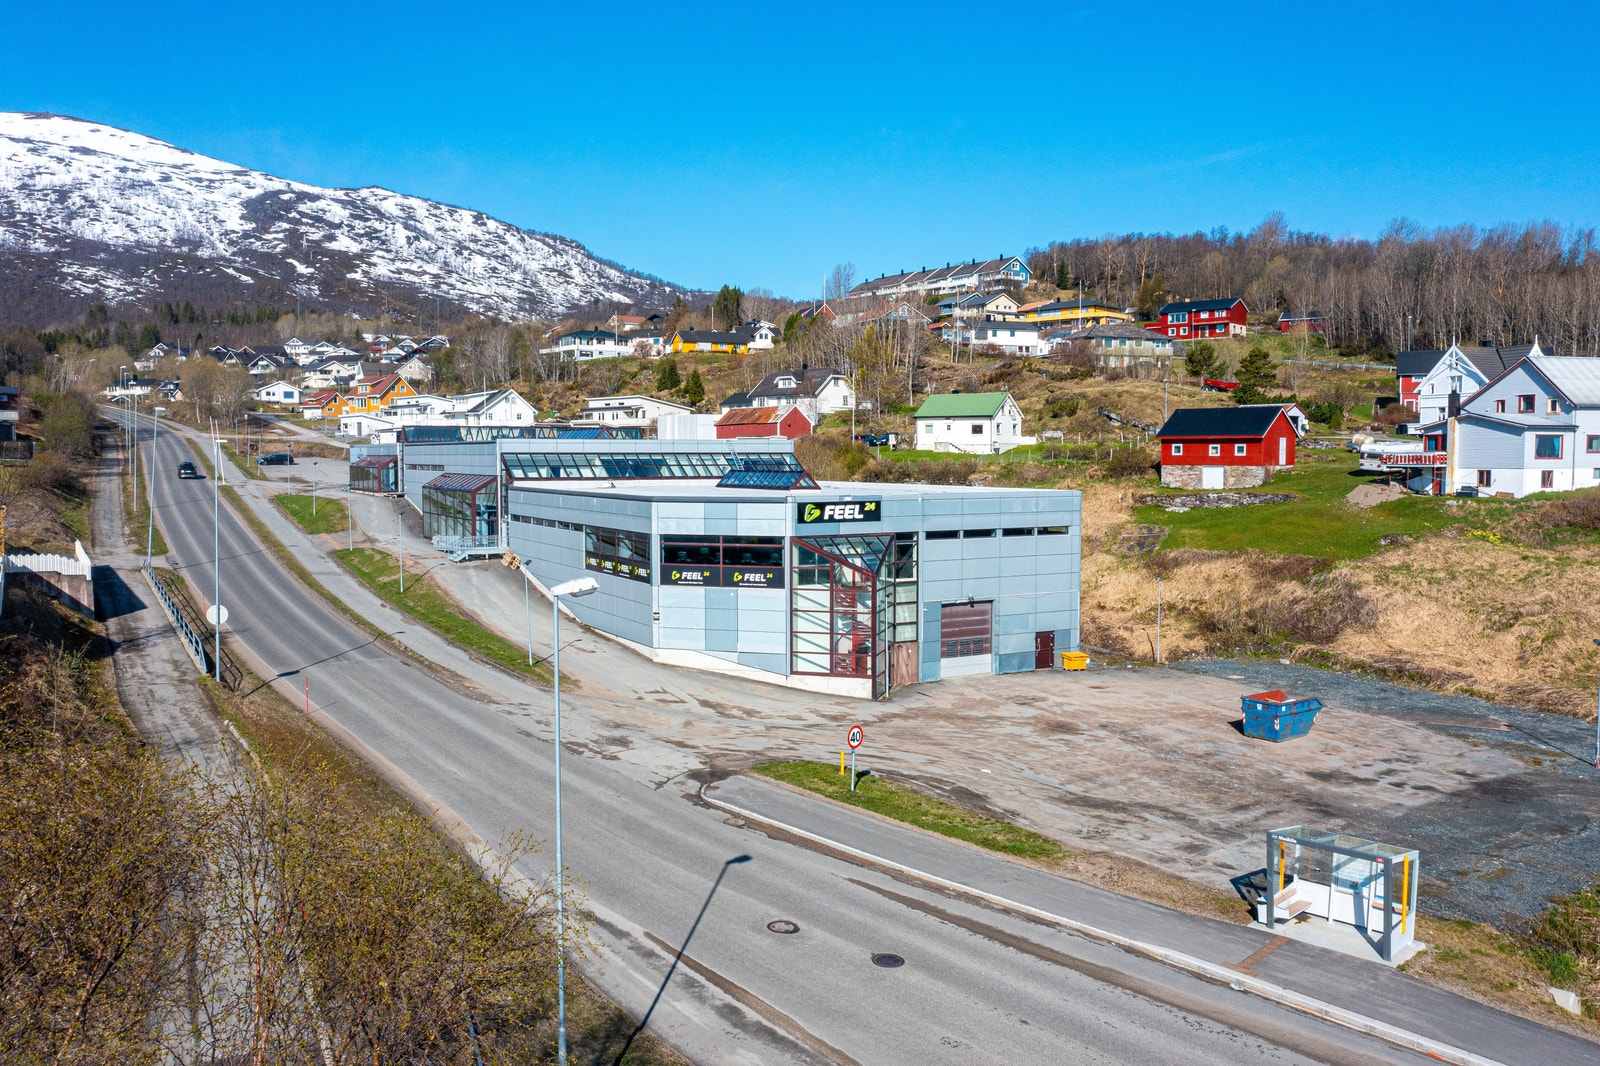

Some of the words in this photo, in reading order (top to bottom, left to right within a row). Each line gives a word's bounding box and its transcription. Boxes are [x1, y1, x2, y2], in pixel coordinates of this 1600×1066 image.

[824, 505, 864, 520] FEEL
[864, 502, 876, 510] 24
[682, 572, 704, 580] FEEL
[744, 574, 766, 582] FEEL
[850, 730, 860, 742] 40
